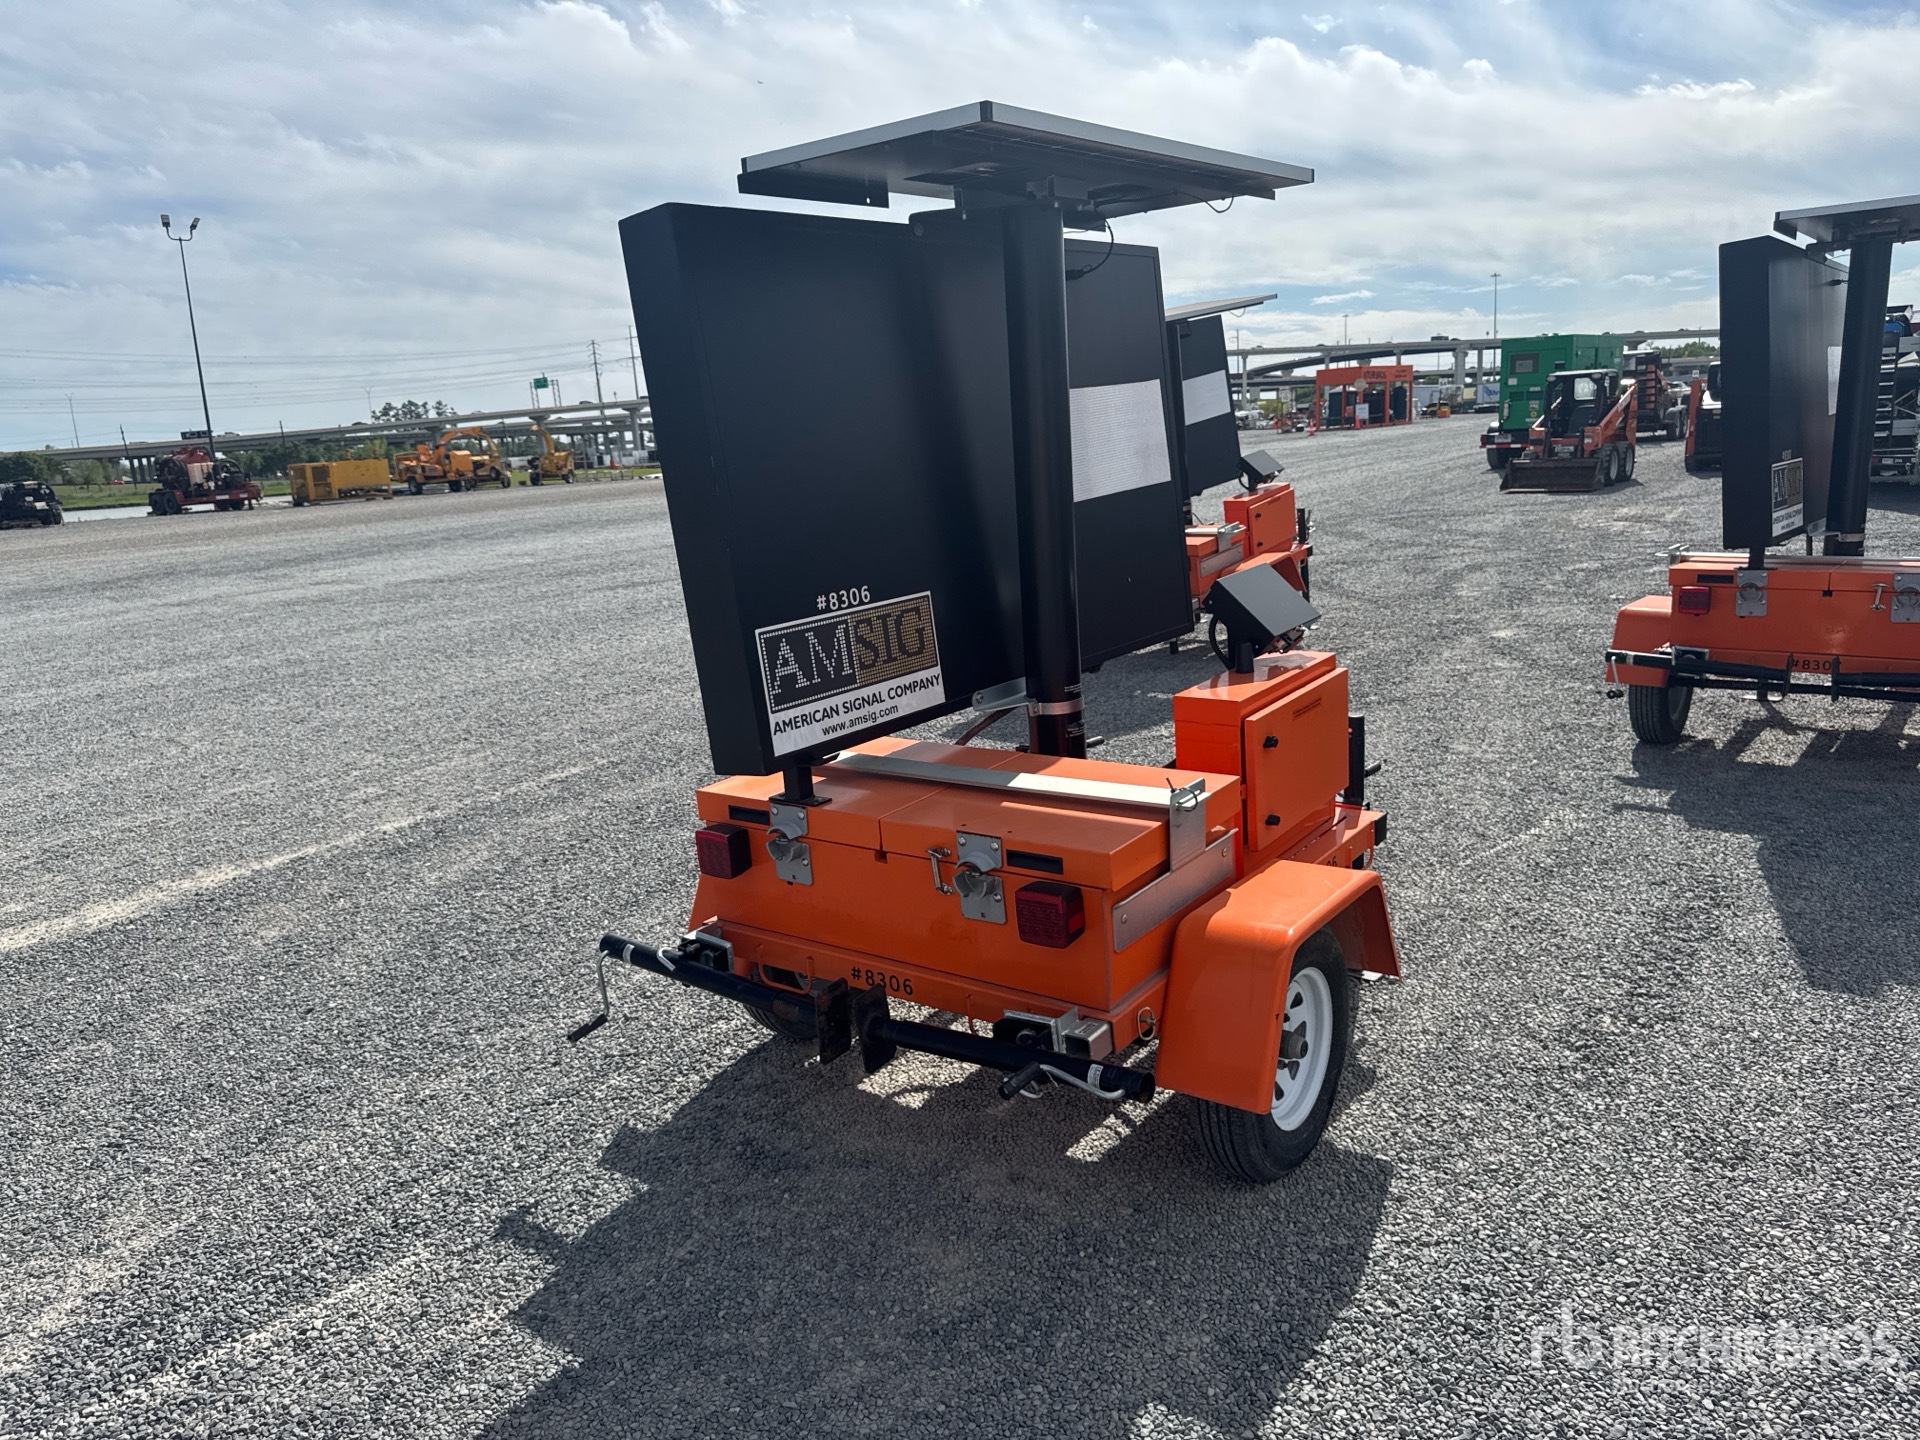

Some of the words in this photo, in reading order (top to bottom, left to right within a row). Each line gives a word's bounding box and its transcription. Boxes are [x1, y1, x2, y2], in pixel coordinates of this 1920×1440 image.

[817, 586, 871, 610] #8306
[769, 608, 925, 694] AMSIG
[1793, 658, 1842, 671] #830
[773, 707, 840, 736] AMERICAN
[843, 690, 886, 714] SIGNAL
[887, 673, 941, 700] COMPANY
[821, 704, 899, 736] www.amsig.com
[851, 967, 913, 995] #8306
